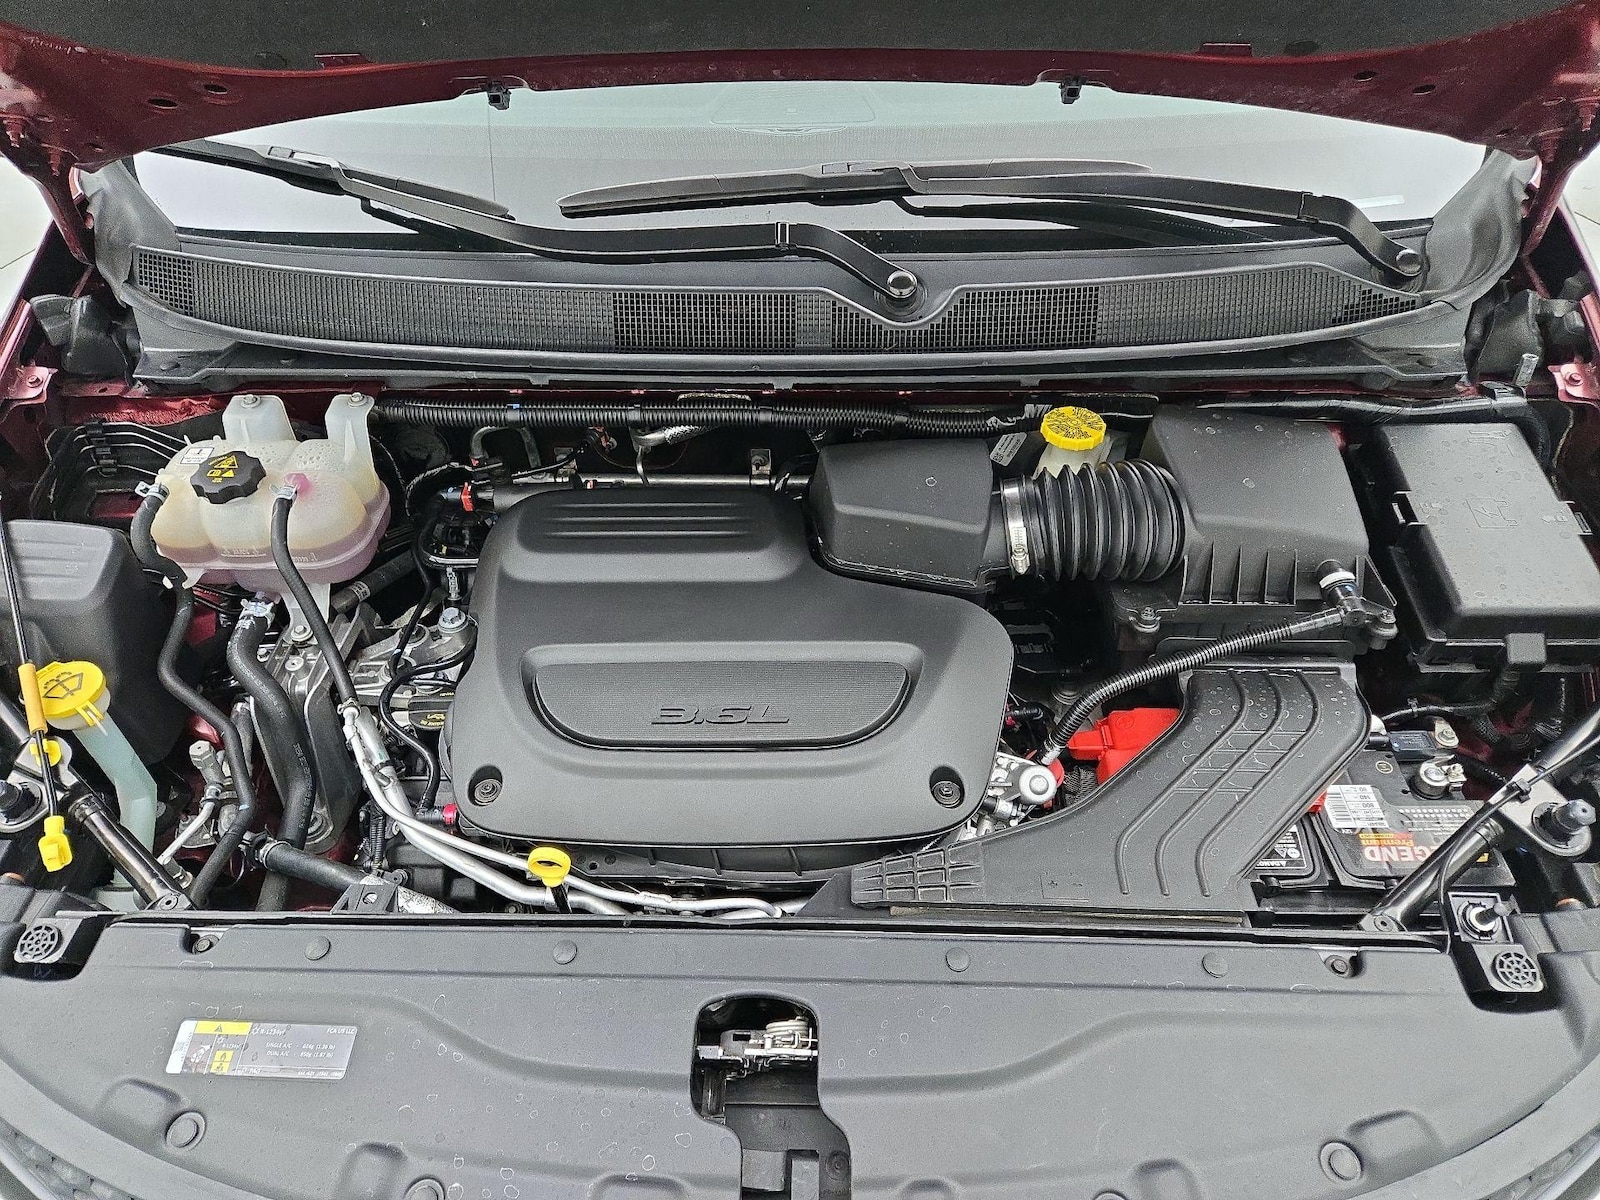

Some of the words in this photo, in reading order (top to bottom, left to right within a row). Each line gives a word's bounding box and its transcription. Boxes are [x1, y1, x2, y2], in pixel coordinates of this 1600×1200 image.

[651, 705, 789, 724] 3.6L
[1361, 839, 1414, 847] Premium
[1364, 846, 1438, 862] GEND
